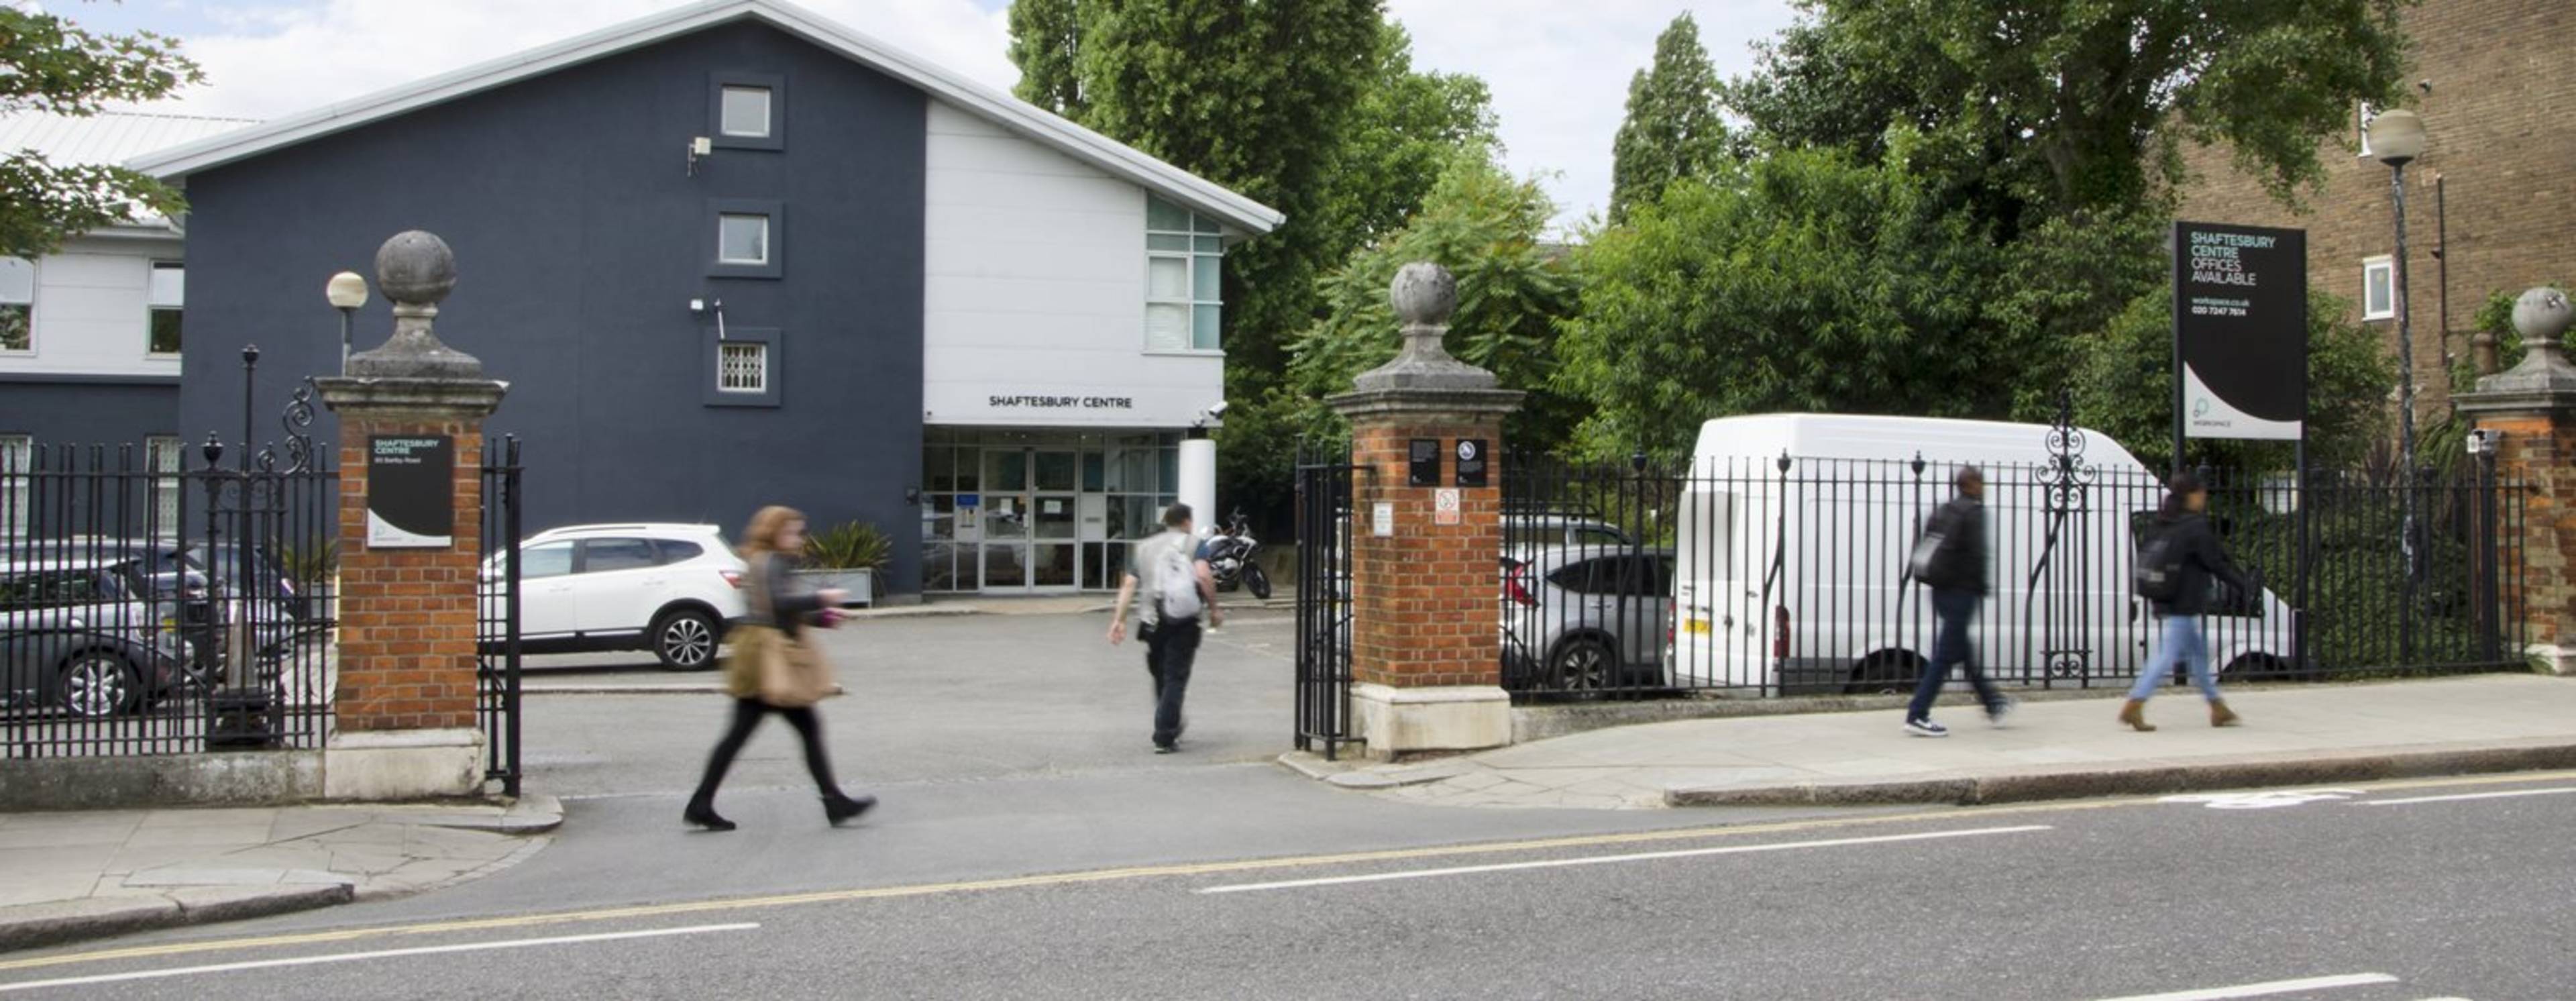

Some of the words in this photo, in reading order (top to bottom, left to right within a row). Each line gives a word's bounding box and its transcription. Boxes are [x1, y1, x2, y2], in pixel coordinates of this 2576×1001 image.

[2190, 231, 2276, 248] SHAFTESBURY
[2191, 245, 2239, 258] CENTRE
[2191, 257, 2242, 272] OFFICES
[2192, 270, 2257, 286] AVAILABLE
[2192, 305, 2208, 315] 020
[2208, 306, 2228, 315] 7247
[989, 396, 1081, 408] SHAFTESBURY
[1083, 397, 1132, 409] CENTRE
[374, 439, 439, 447] SHAFTESBURY
[374, 447, 411, 455] CENTRE
